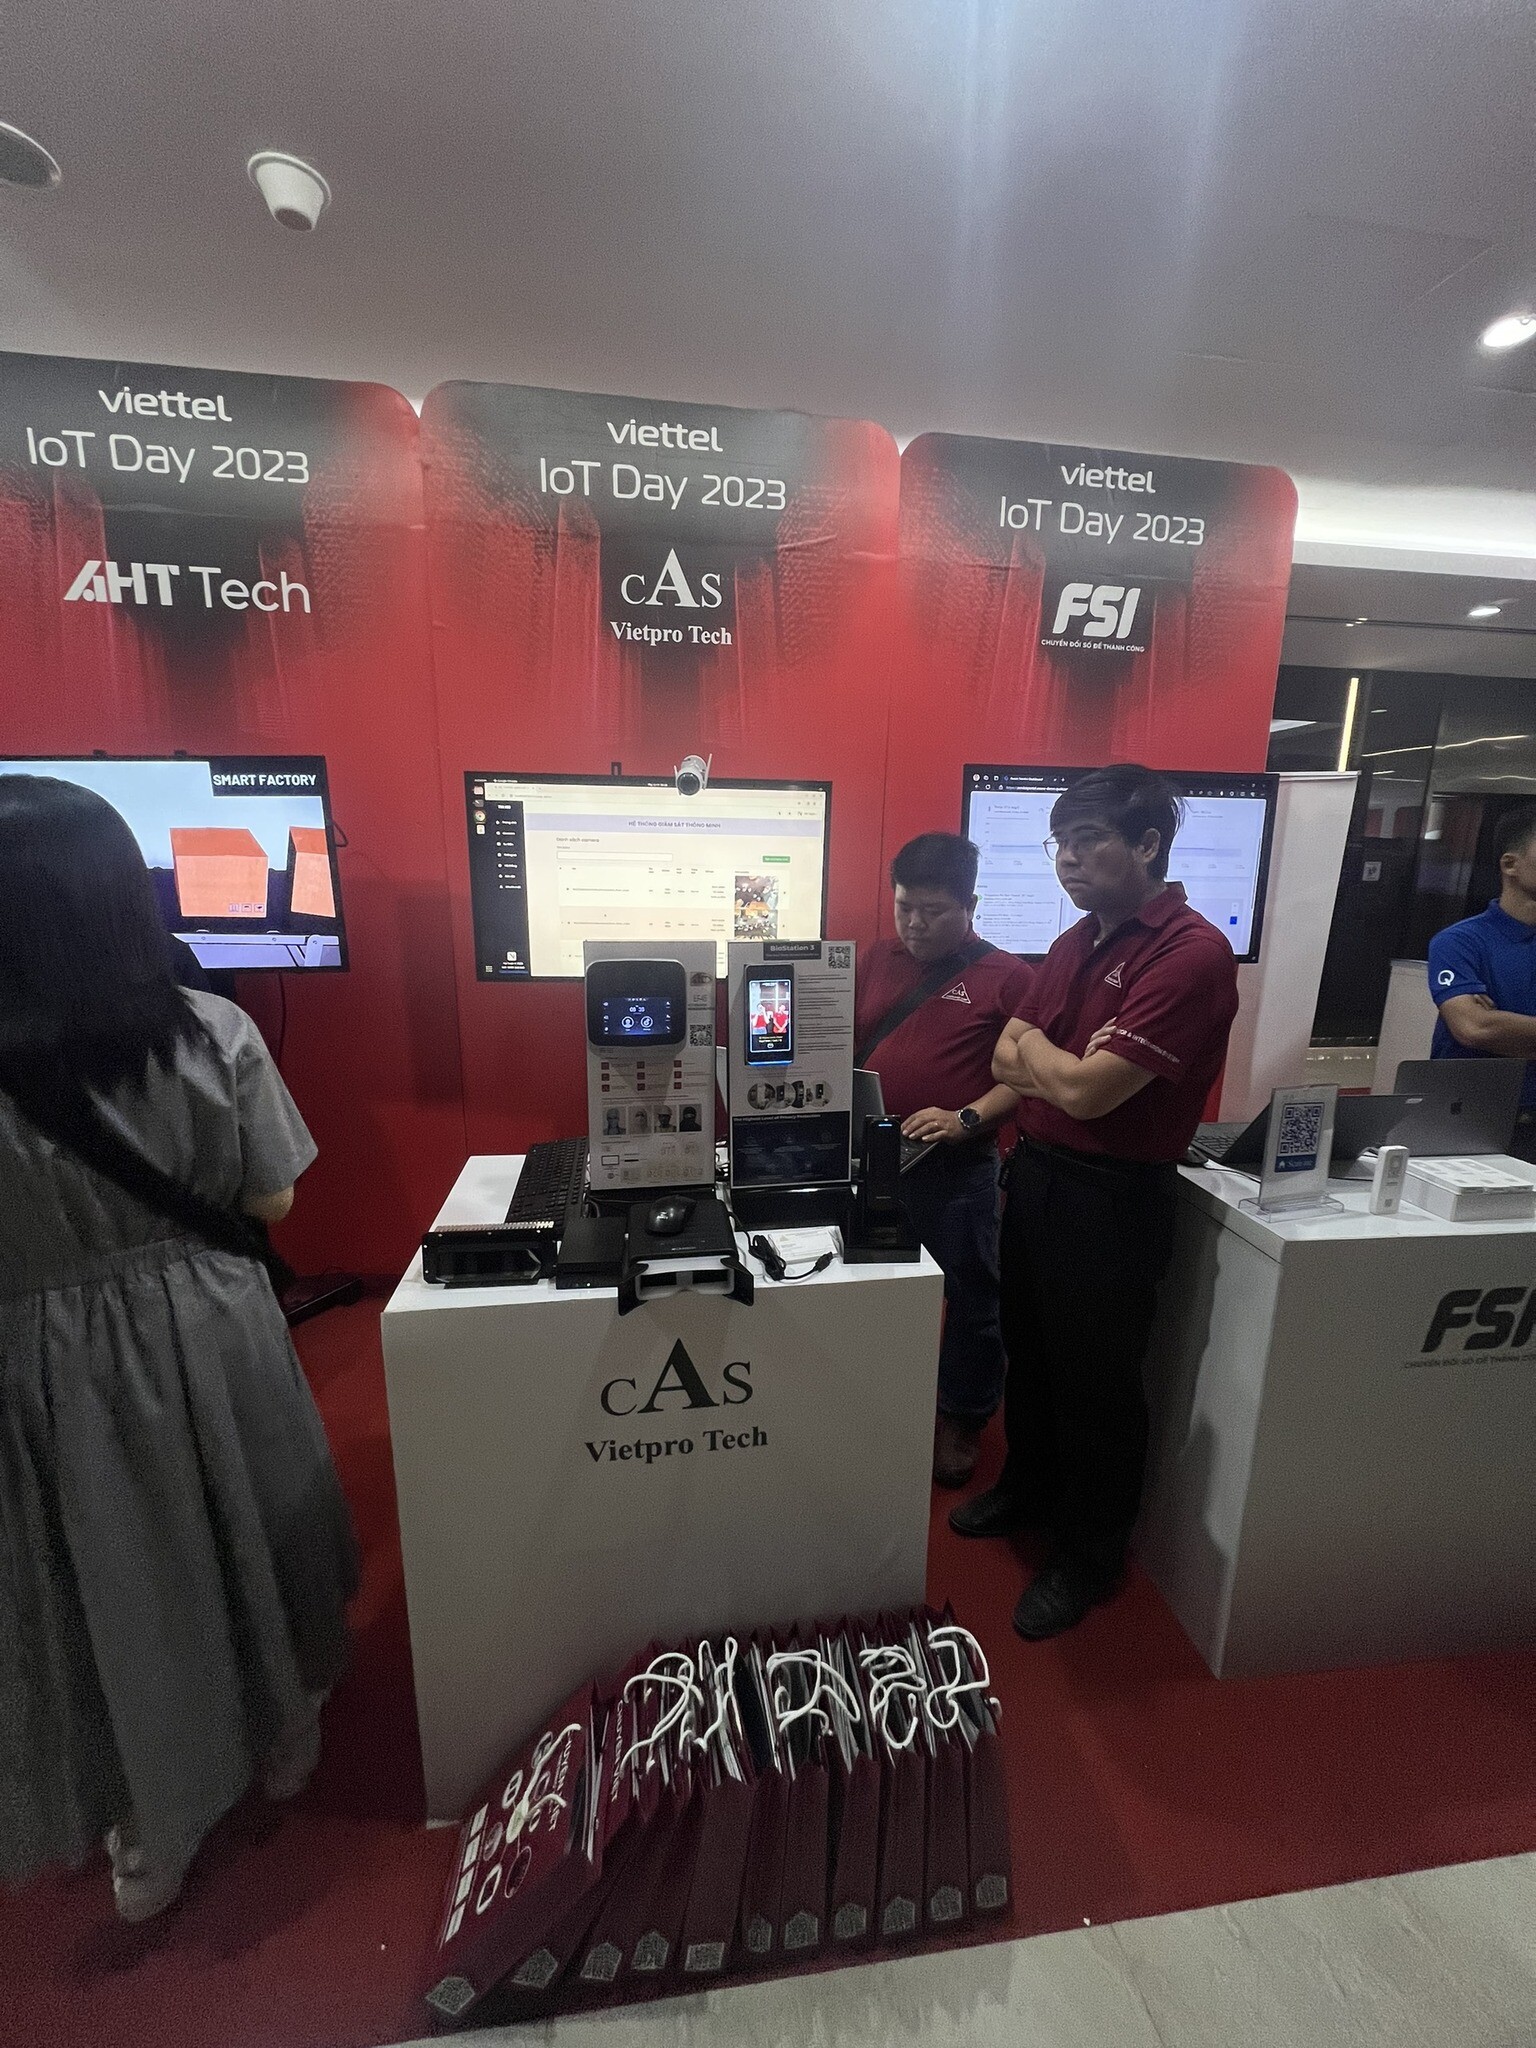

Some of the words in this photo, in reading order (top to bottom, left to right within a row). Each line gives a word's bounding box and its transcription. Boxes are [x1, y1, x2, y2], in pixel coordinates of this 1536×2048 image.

[98, 386, 232, 422] viettel
[606, 418, 723, 452] viettel
[26, 427, 95, 468] IoT
[109, 433, 195, 483] Day
[212, 445, 309, 484] 2023
[540, 457, 601, 496] IoT
[613, 463, 688, 510] Day
[701, 474, 786, 510] 2023
[1061, 463, 1156, 493] viettel
[1000, 496, 1052, 531] IoT
[1059, 502, 1124, 544] Day
[1132, 512, 1205, 546] 2023
[63, 560, 180, 606] AHT
[189, 566, 311, 613] Tech
[1052, 582, 1141, 639] FSI
[610, 621, 683, 646] Vietpro
[688, 625, 733, 645] Tech
[212, 774, 257, 786] SMART
[258, 774, 317, 786] FACTORY
[770, 944, 809, 952] BioStation
[585, 1437, 694, 1464] Vietpro
[702, 1426, 768, 1451] Tech
